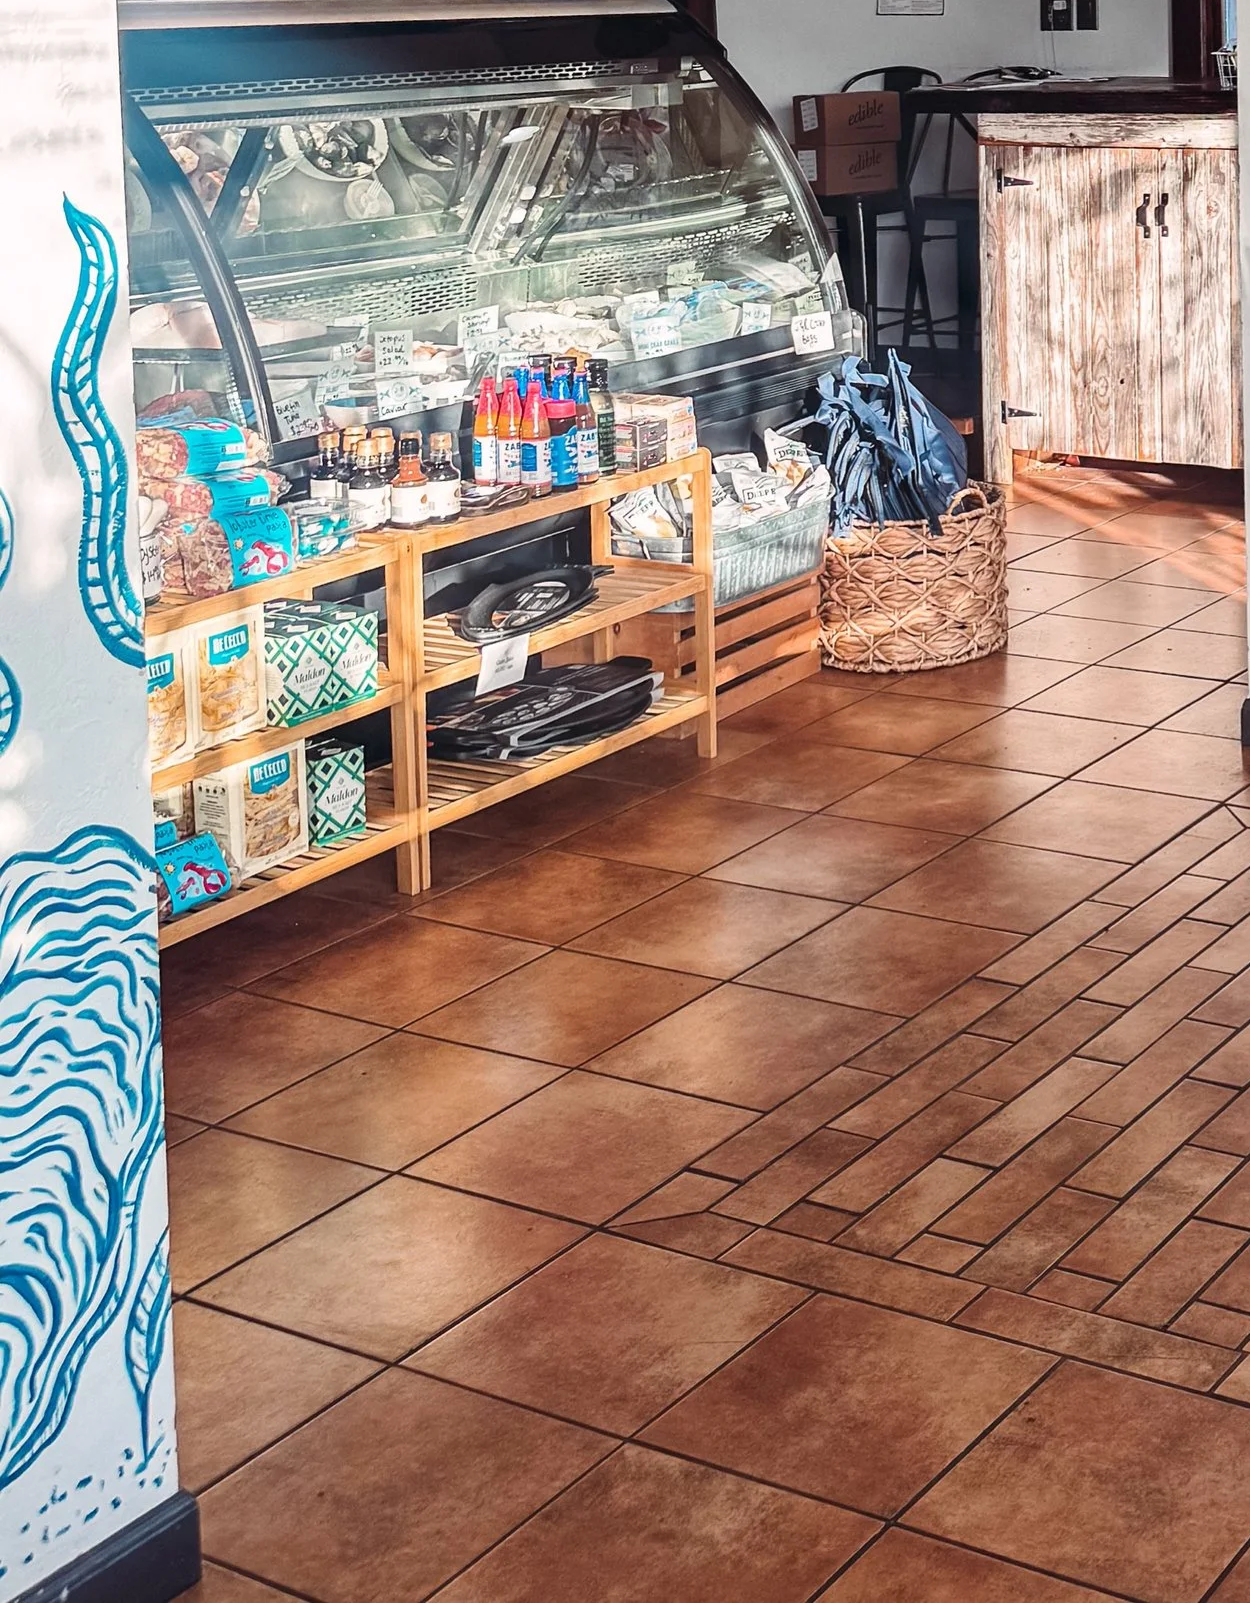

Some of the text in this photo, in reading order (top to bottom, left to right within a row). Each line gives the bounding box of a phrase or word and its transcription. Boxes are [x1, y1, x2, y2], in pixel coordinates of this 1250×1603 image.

[849, 99, 884, 126] edible
[849, 149, 882, 175] edible
[381, 402, 407, 416] Caviar
[229, 518, 257, 534] lobster
[342, 651, 372, 671] Maldon
[294, 666, 325, 685] Maldon
[326, 787, 358, 804] Maldon
